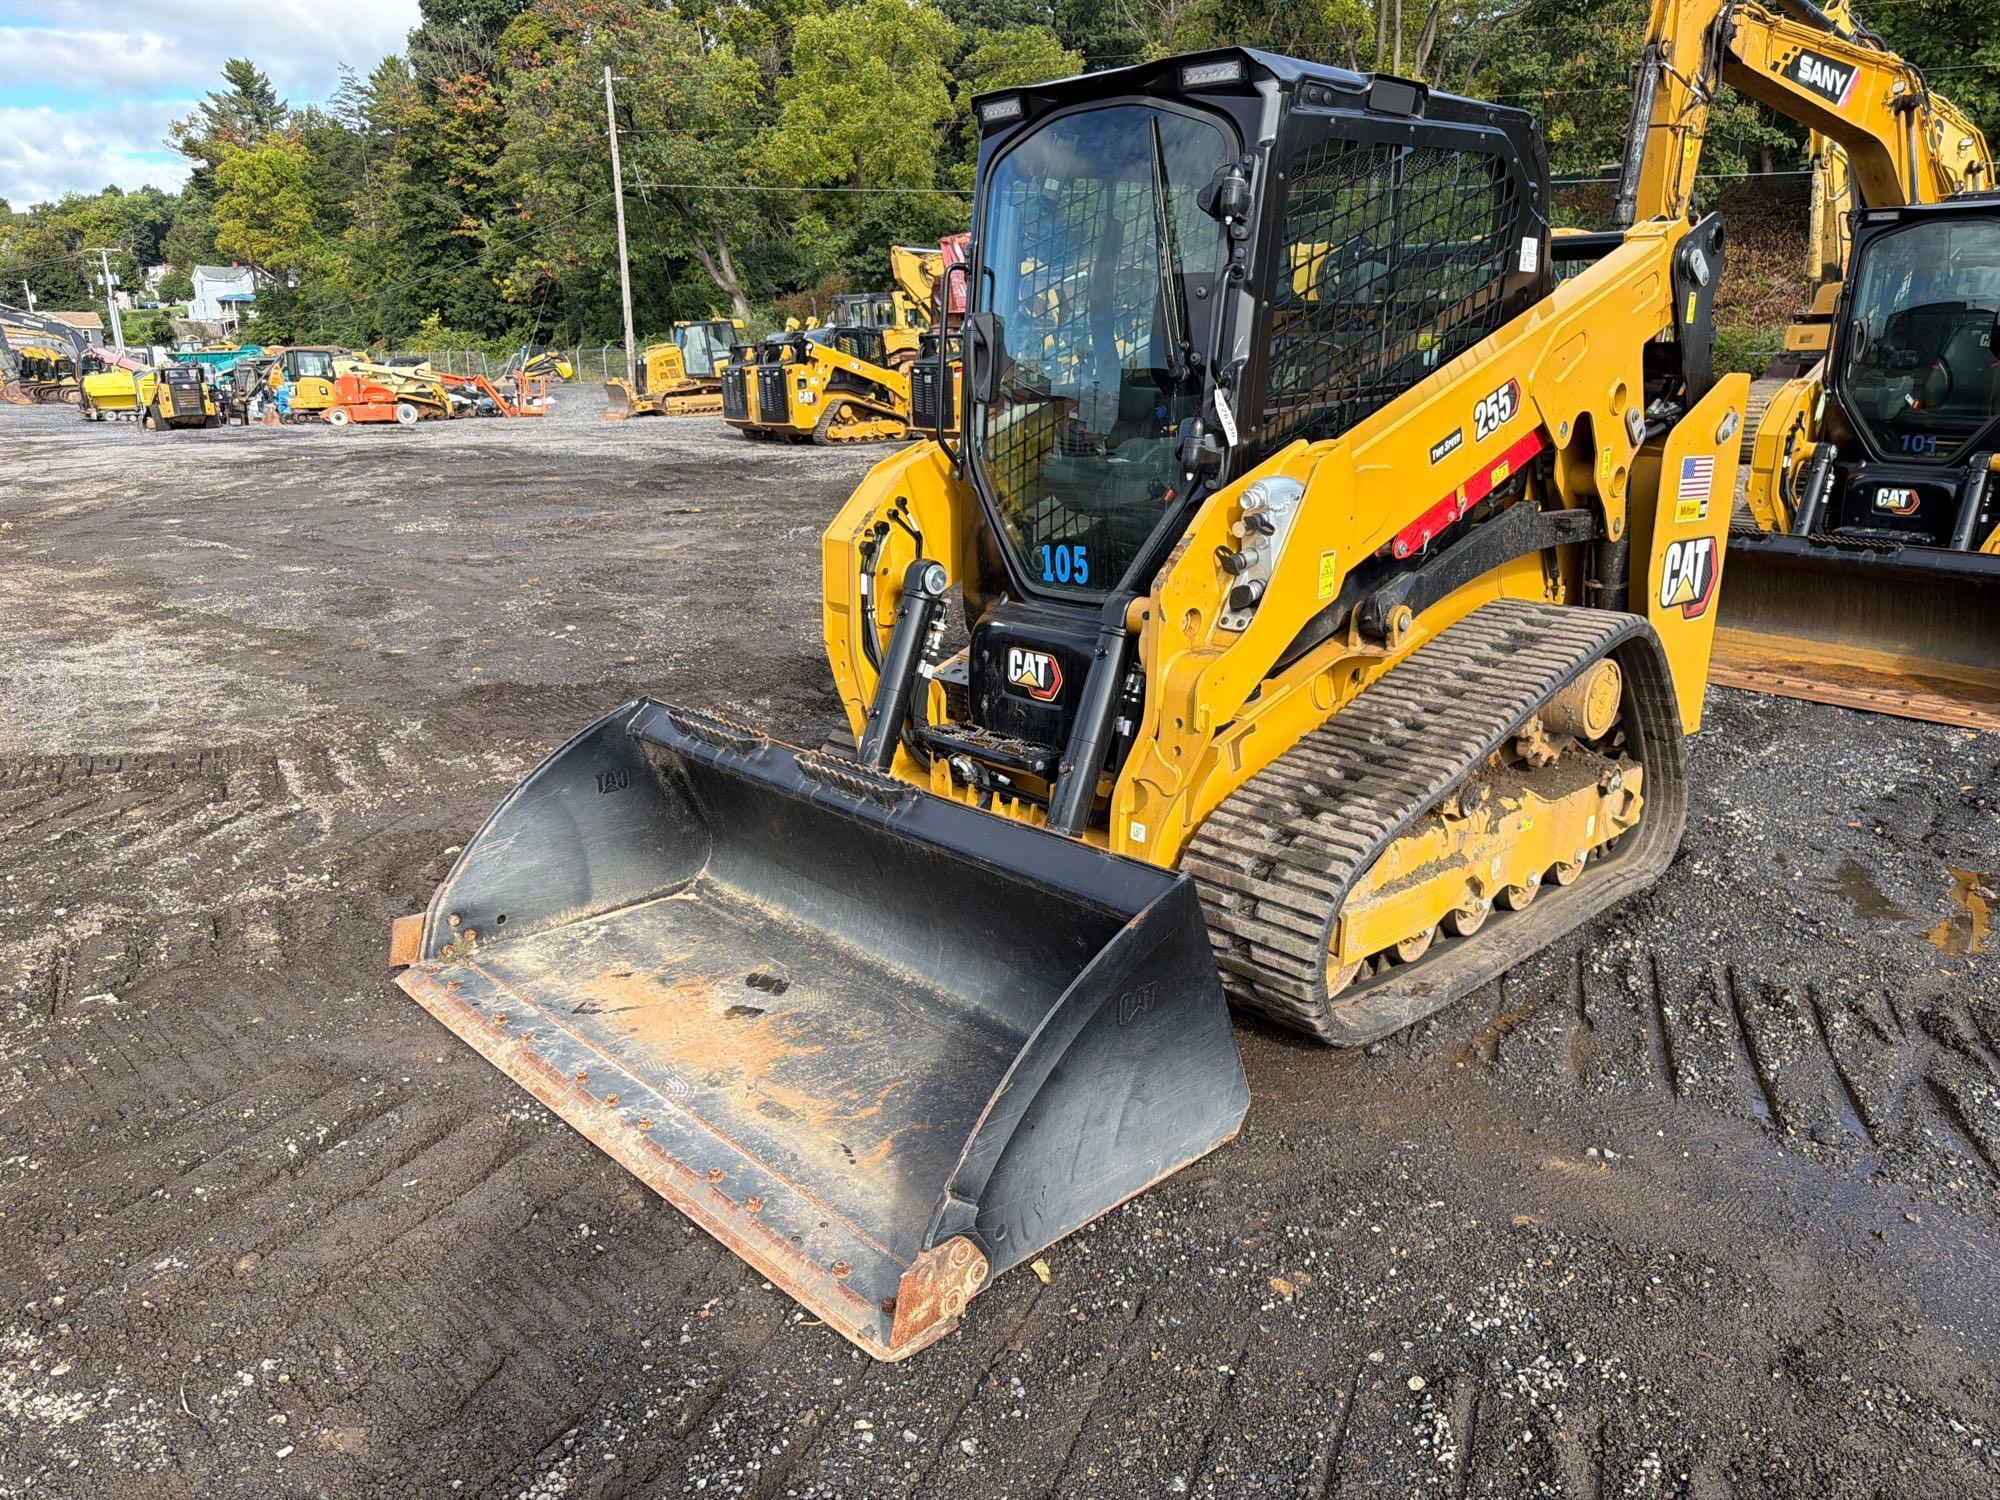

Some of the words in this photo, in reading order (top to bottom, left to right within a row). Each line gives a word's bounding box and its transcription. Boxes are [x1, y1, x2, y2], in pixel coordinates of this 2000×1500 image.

[1798, 55, 1847, 95] SANY
[799, 391, 814, 404] CAT
[1475, 384, 1511, 440] 255
[1902, 434, 1937, 453] 101
[1877, 488, 1910, 508] CAT
[1042, 544, 1088, 584] 105
[1661, 538, 1711, 607] CAT
[1010, 649, 1048, 688] CAT
[1119, 980, 1160, 1026] CAT
